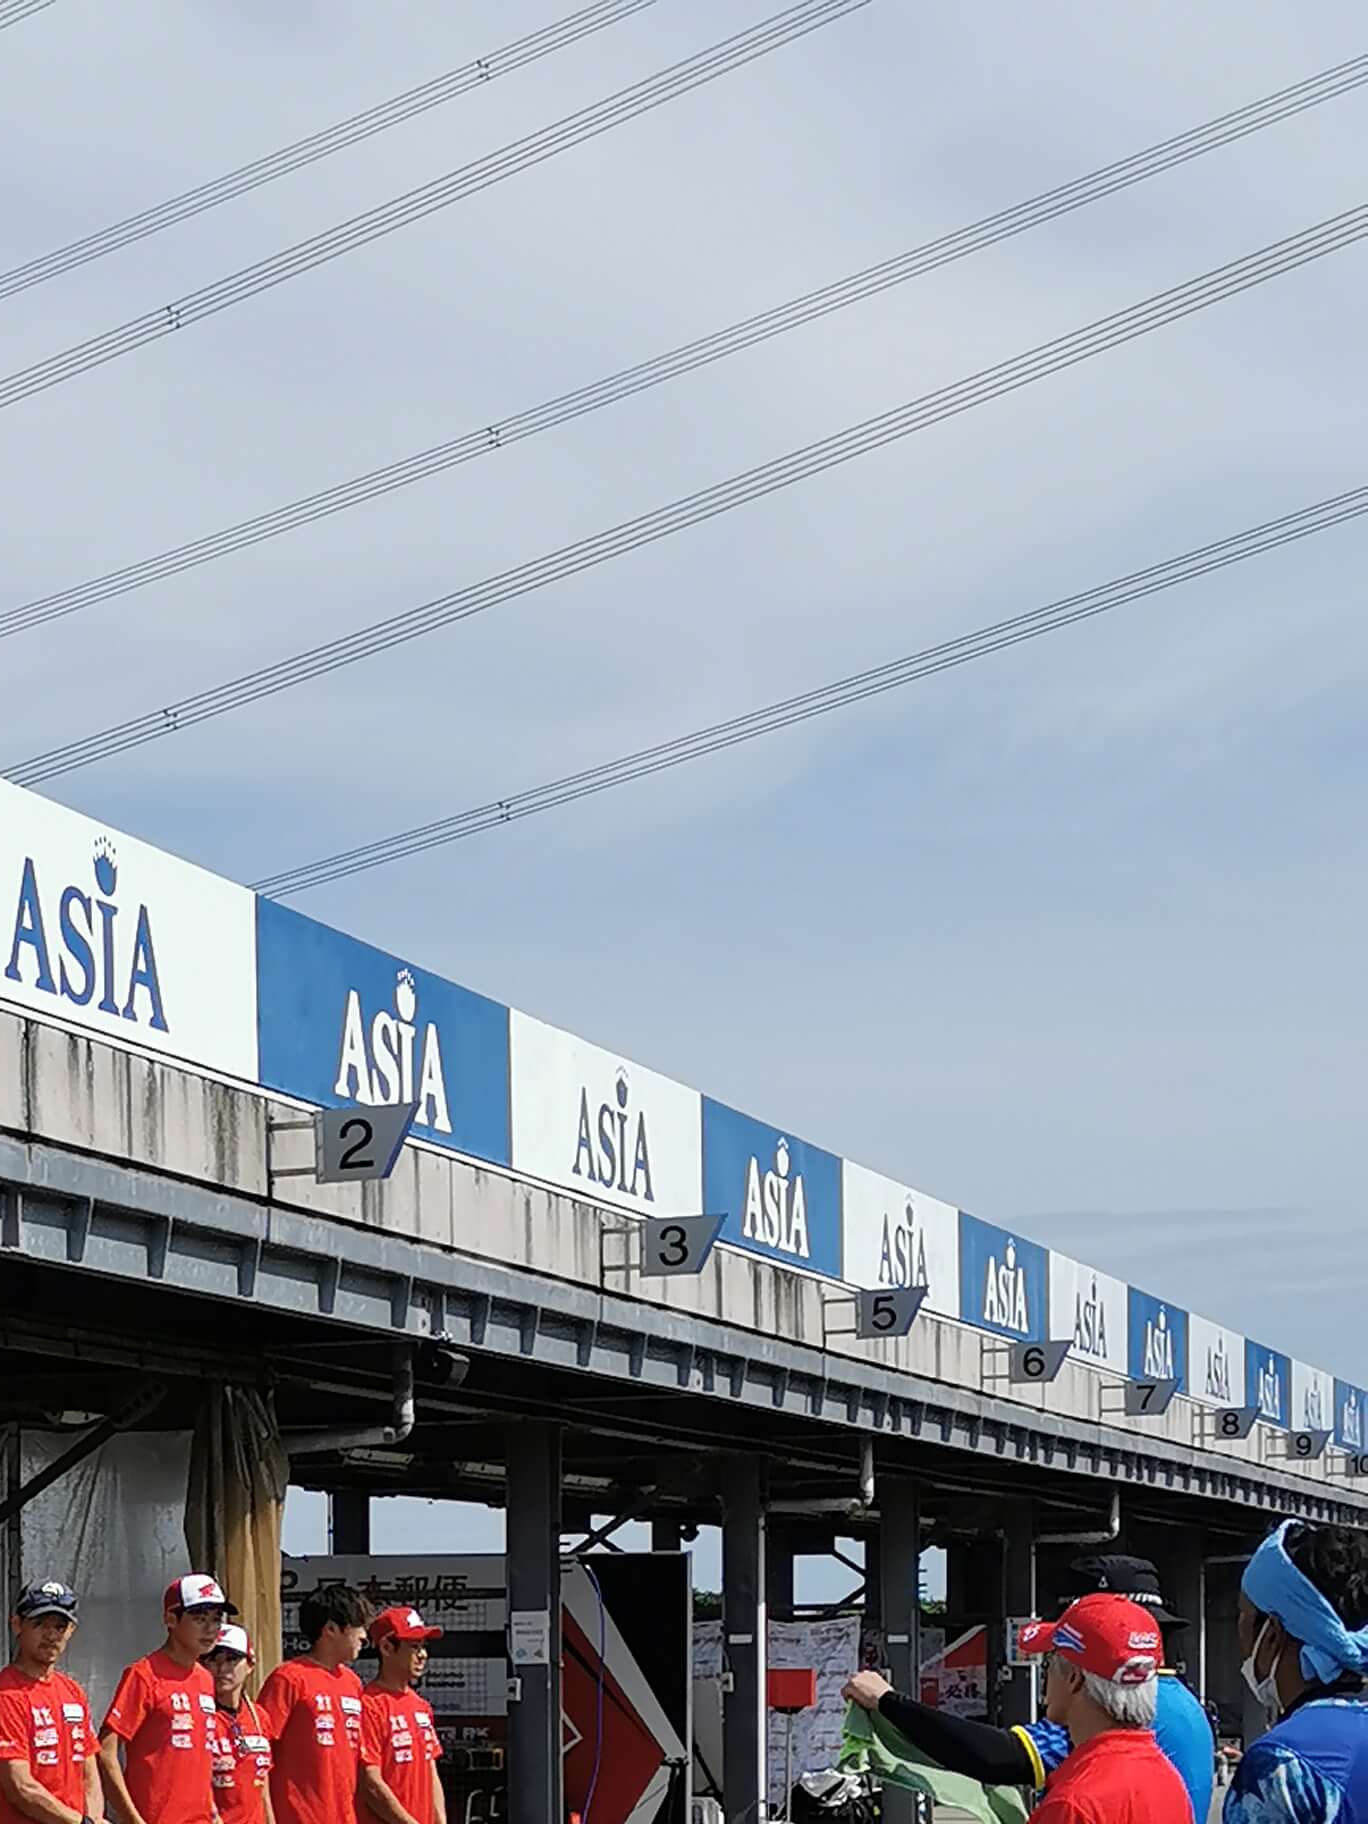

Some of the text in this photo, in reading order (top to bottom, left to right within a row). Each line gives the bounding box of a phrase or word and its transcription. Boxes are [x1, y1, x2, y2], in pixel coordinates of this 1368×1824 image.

[4, 838, 170, 1034] ASIA
[335, 970, 452, 1134] ASIA
[338, 1118, 374, 1170] 2
[572, 1068, 655, 1202] ASIA
[743, 1138, 810, 1259] ASIA
[658, 1225, 689, 1267] 3
[879, 1197, 930, 1292] ASIA
[871, 1296, 897, 1330] 5
[984, 1240, 1029, 1334] ASIA
[1072, 1276, 1108, 1359] ASIA
[1023, 1346, 1045, 1377] 6
[1136, 1384, 1156, 1410] 7
[1221, 1411, 1240, 1436] 8
[1295, 1434, 1312, 1456] 9
